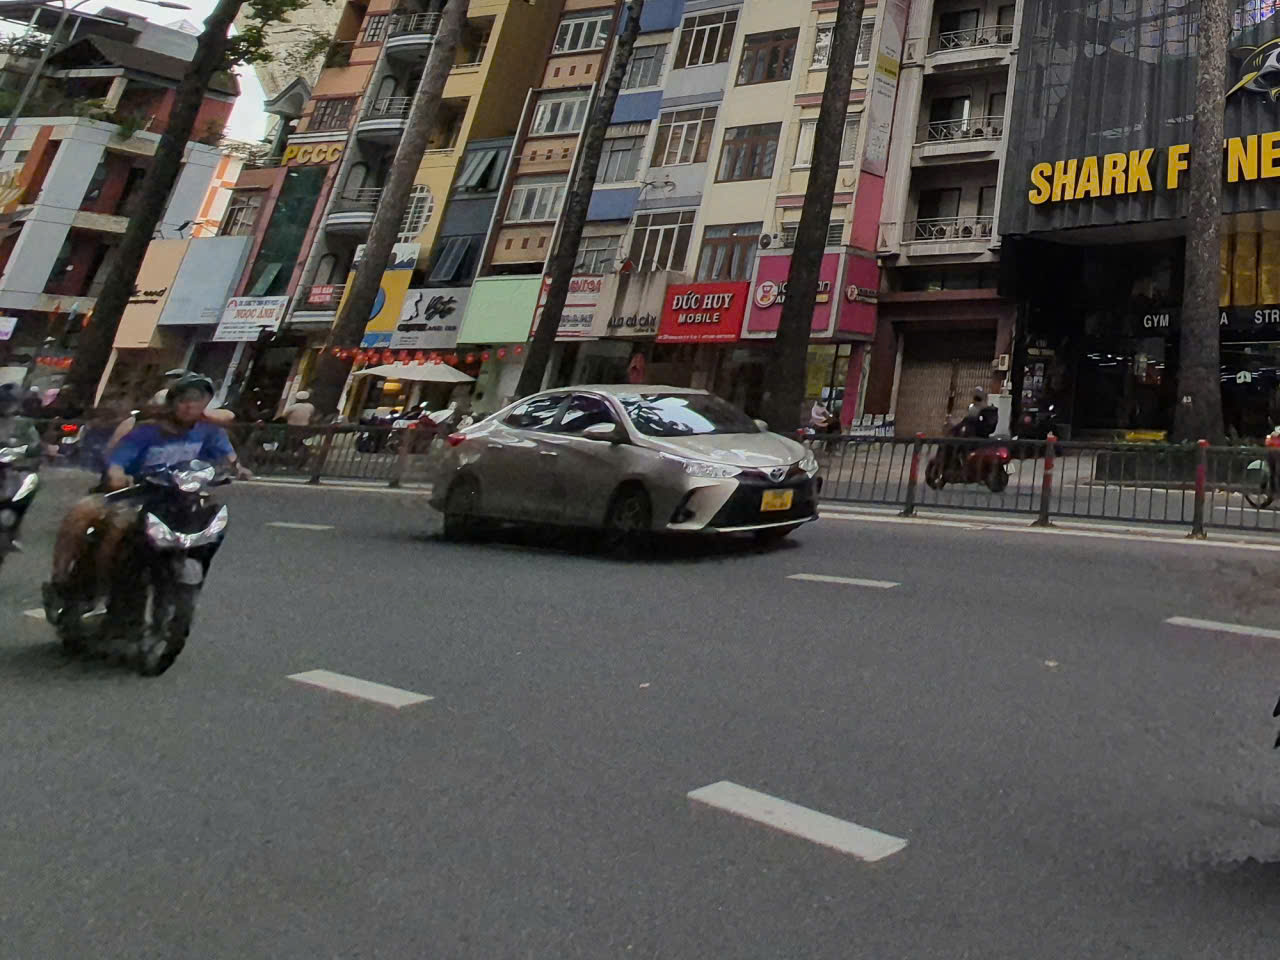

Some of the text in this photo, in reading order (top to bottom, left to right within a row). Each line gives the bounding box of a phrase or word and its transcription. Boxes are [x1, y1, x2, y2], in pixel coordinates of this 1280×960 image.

[281, 143, 345, 167] PCCC
[1028, 147, 1156, 205] SHARK
[672, 290, 734, 310] ĐỨC HUY
[677, 312, 721, 324] MOBILE
[1143, 314, 1169, 329] GYM
